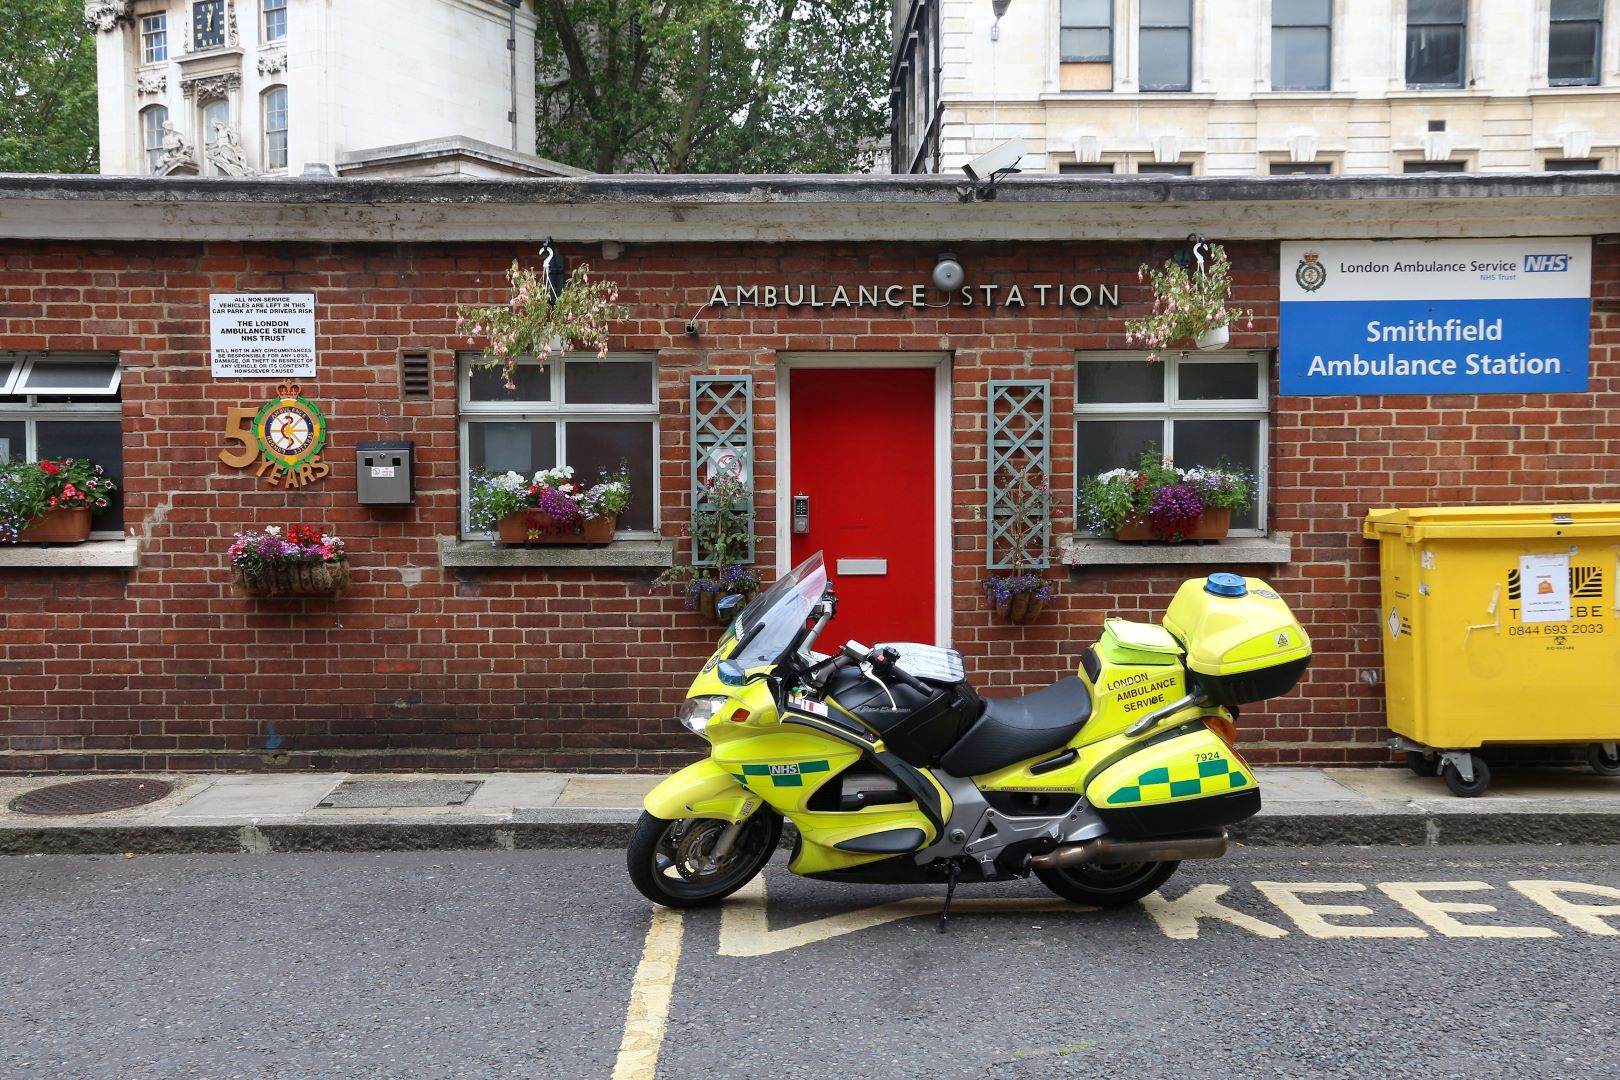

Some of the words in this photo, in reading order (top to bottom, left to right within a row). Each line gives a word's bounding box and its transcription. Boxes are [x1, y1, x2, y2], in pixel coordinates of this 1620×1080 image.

[1340, 262, 1390, 274] London
[1393, 261, 1466, 273] Ambulance
[1470, 260, 1517, 272] Service
[1525, 254, 1568, 272] NHS
[1480, 274, 1497, 282] NHS
[1498, 273, 1517, 281] Trust
[708, 284, 925, 308] AMBULANCE
[961, 284, 1119, 307] STATION
[1366, 319, 1503, 343] Smithfield
[1307, 353, 1457, 377] Ambulance
[1465, 352, 1562, 375] Station
[255, 452, 330, 489] YEARS
[1508, 626, 1540, 636] 0844
[1544, 625, 1568, 635] 693
[1572, 624, 1604, 634] 2033
[1107, 672, 1149, 691] LONDON
[1117, 677, 1177, 702] AMBULANCE
[1194, 751, 1220, 762] 7924
[771, 764, 798, 774] NHS
